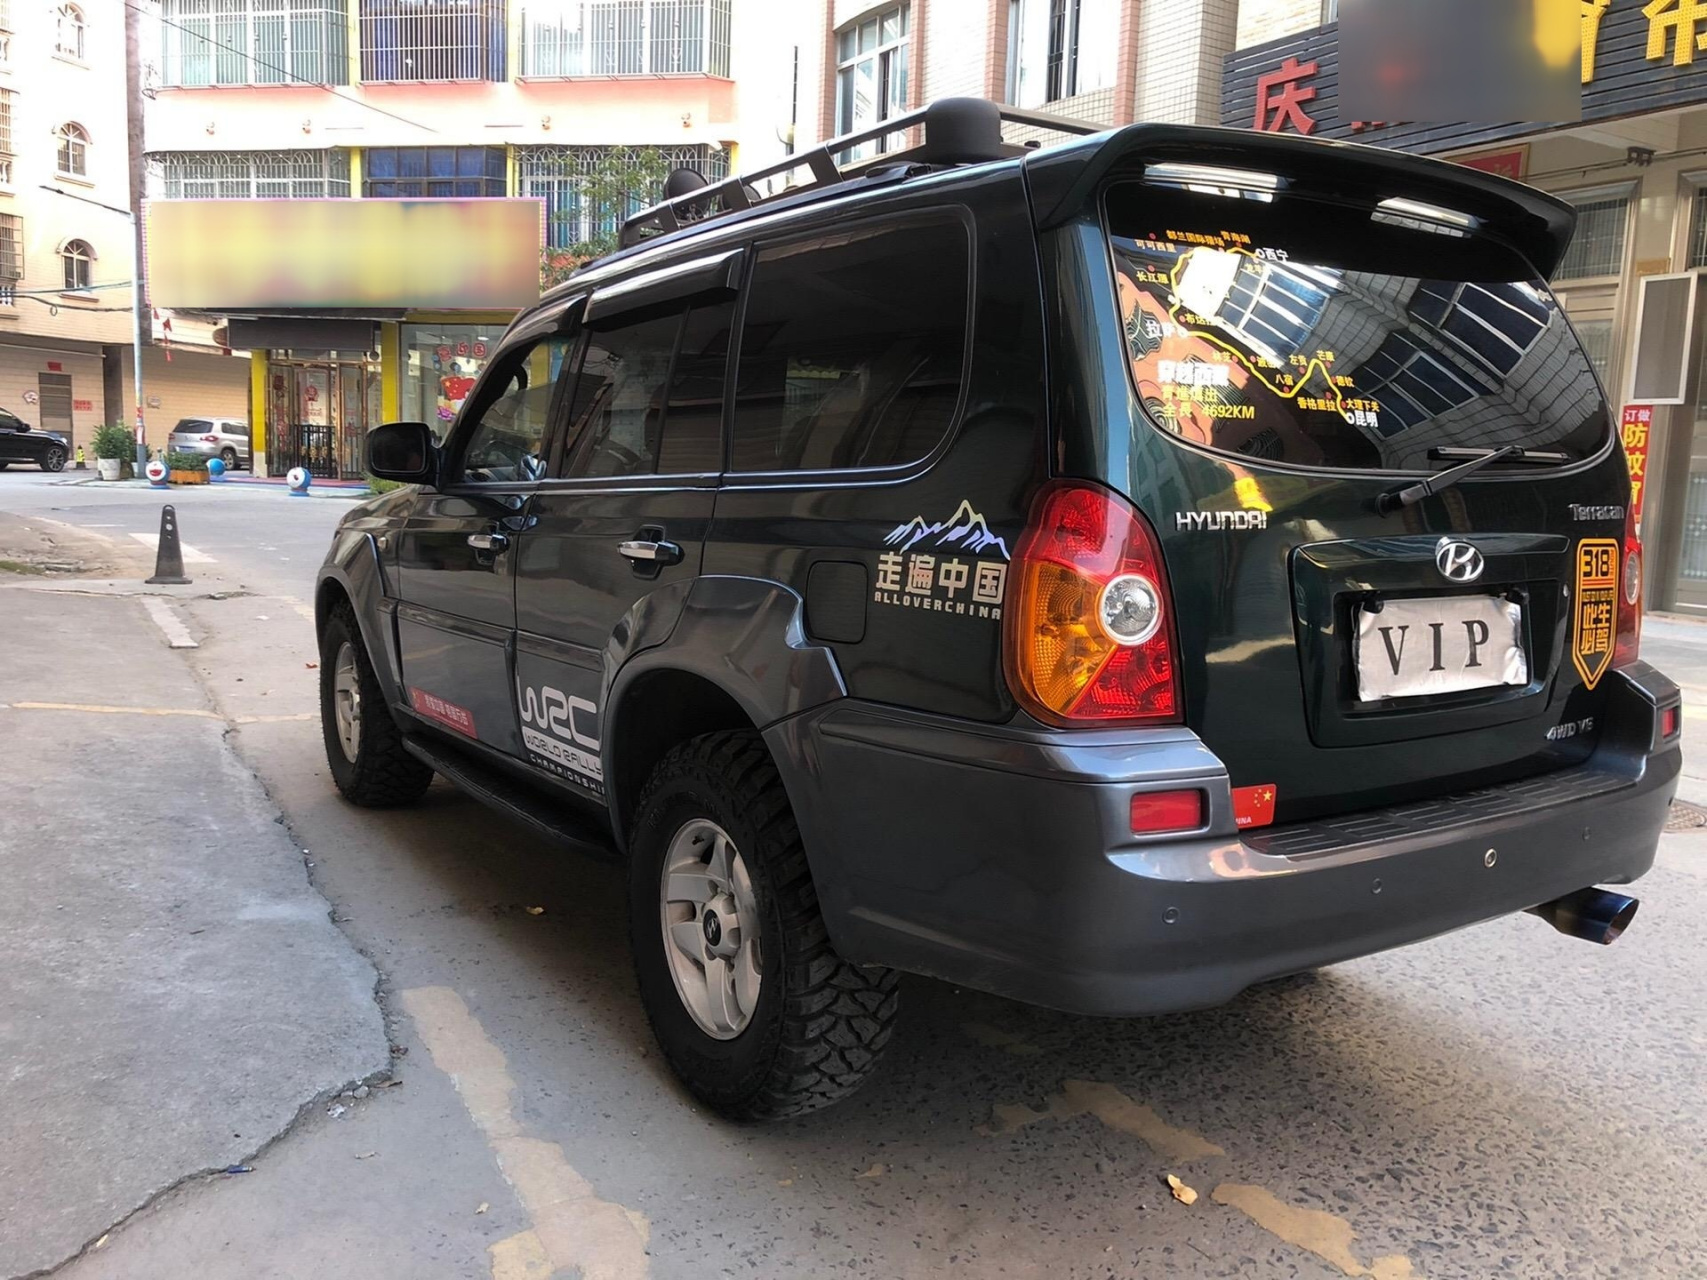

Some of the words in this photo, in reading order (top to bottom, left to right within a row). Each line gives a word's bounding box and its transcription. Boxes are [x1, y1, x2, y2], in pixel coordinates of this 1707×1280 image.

[1263, 247, 1289, 262] 西宁
[1354, 410, 1379, 427] 昆明
[1176, 511, 1267, 531] HYUNDAI
[1567, 504, 1625, 521] Terracan
[1582, 549, 1610, 577] 318
[876, 551, 1007, 604] 走遍中国
[874, 592, 1001, 620] ALLOVERCHINA
[1583, 603, 1610, 629] 此生
[1378, 619, 1489, 675] VIP
[1581, 628, 1610, 655] 必驾
[516, 676, 600, 751] WRC
[1544, 722, 1577, 740] 4WD
